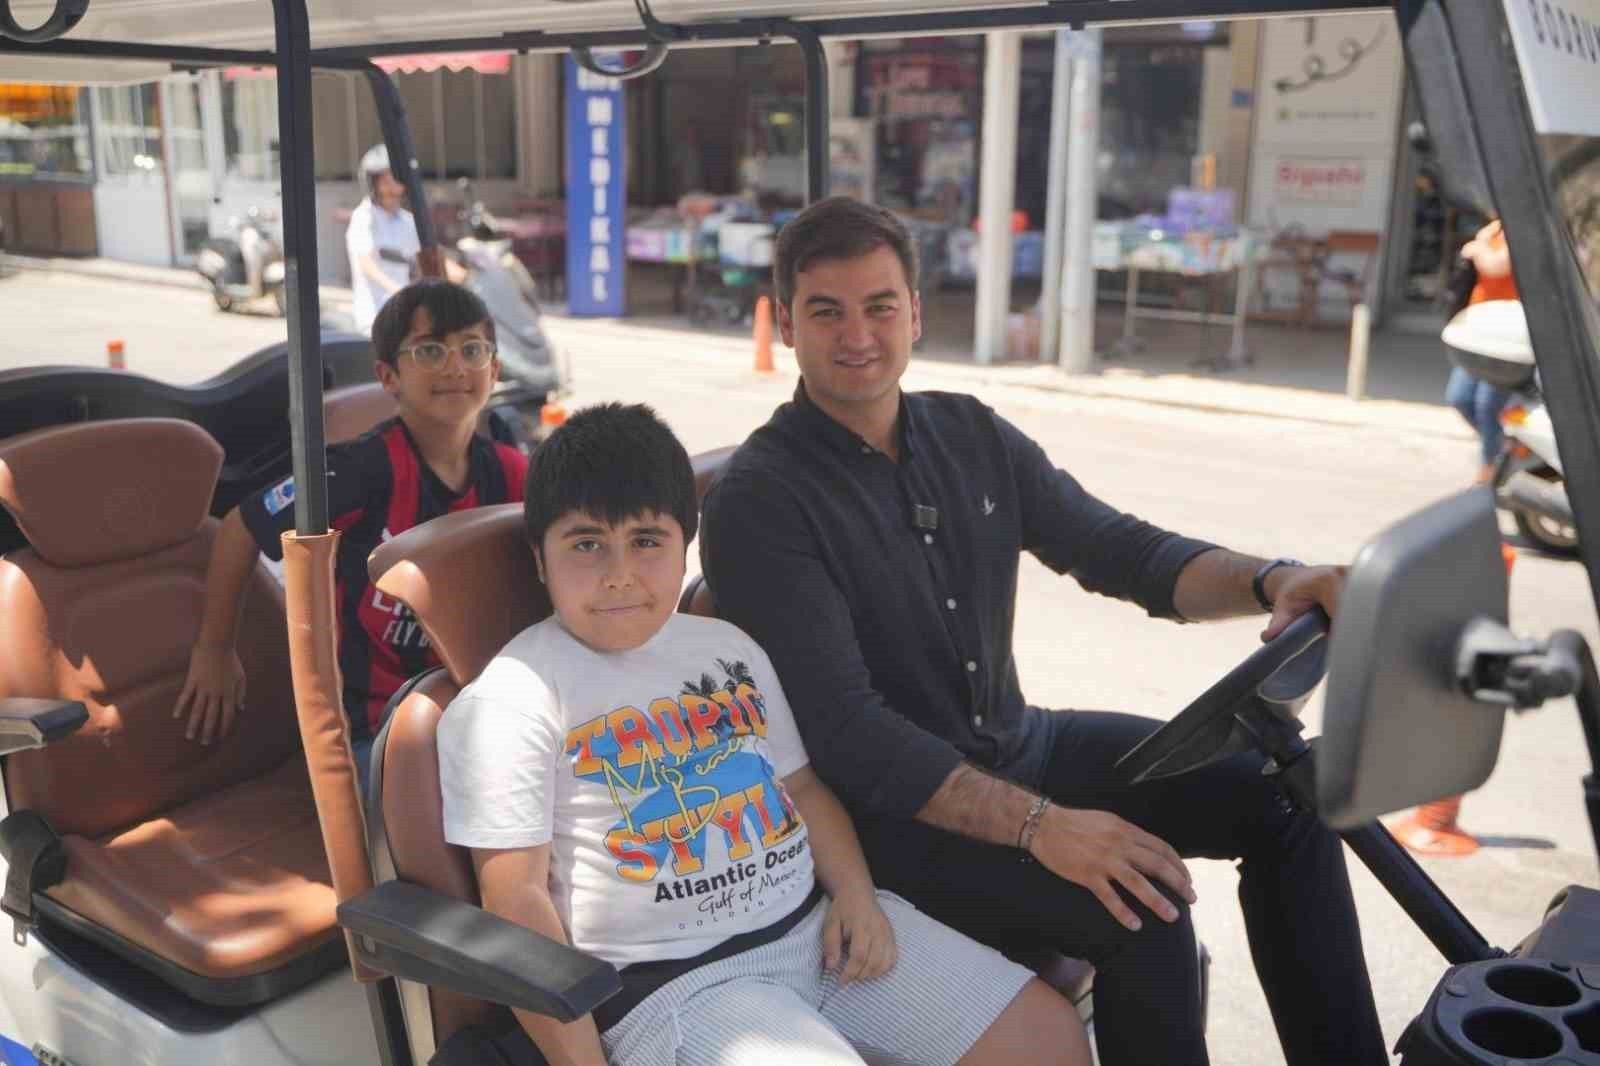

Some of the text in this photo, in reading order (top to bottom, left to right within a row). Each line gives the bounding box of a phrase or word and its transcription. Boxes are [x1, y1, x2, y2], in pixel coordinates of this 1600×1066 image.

[654, 864, 756, 903] Atlantic
[697, 888, 735, 915] Gulf
[740, 880, 754, 902] of
